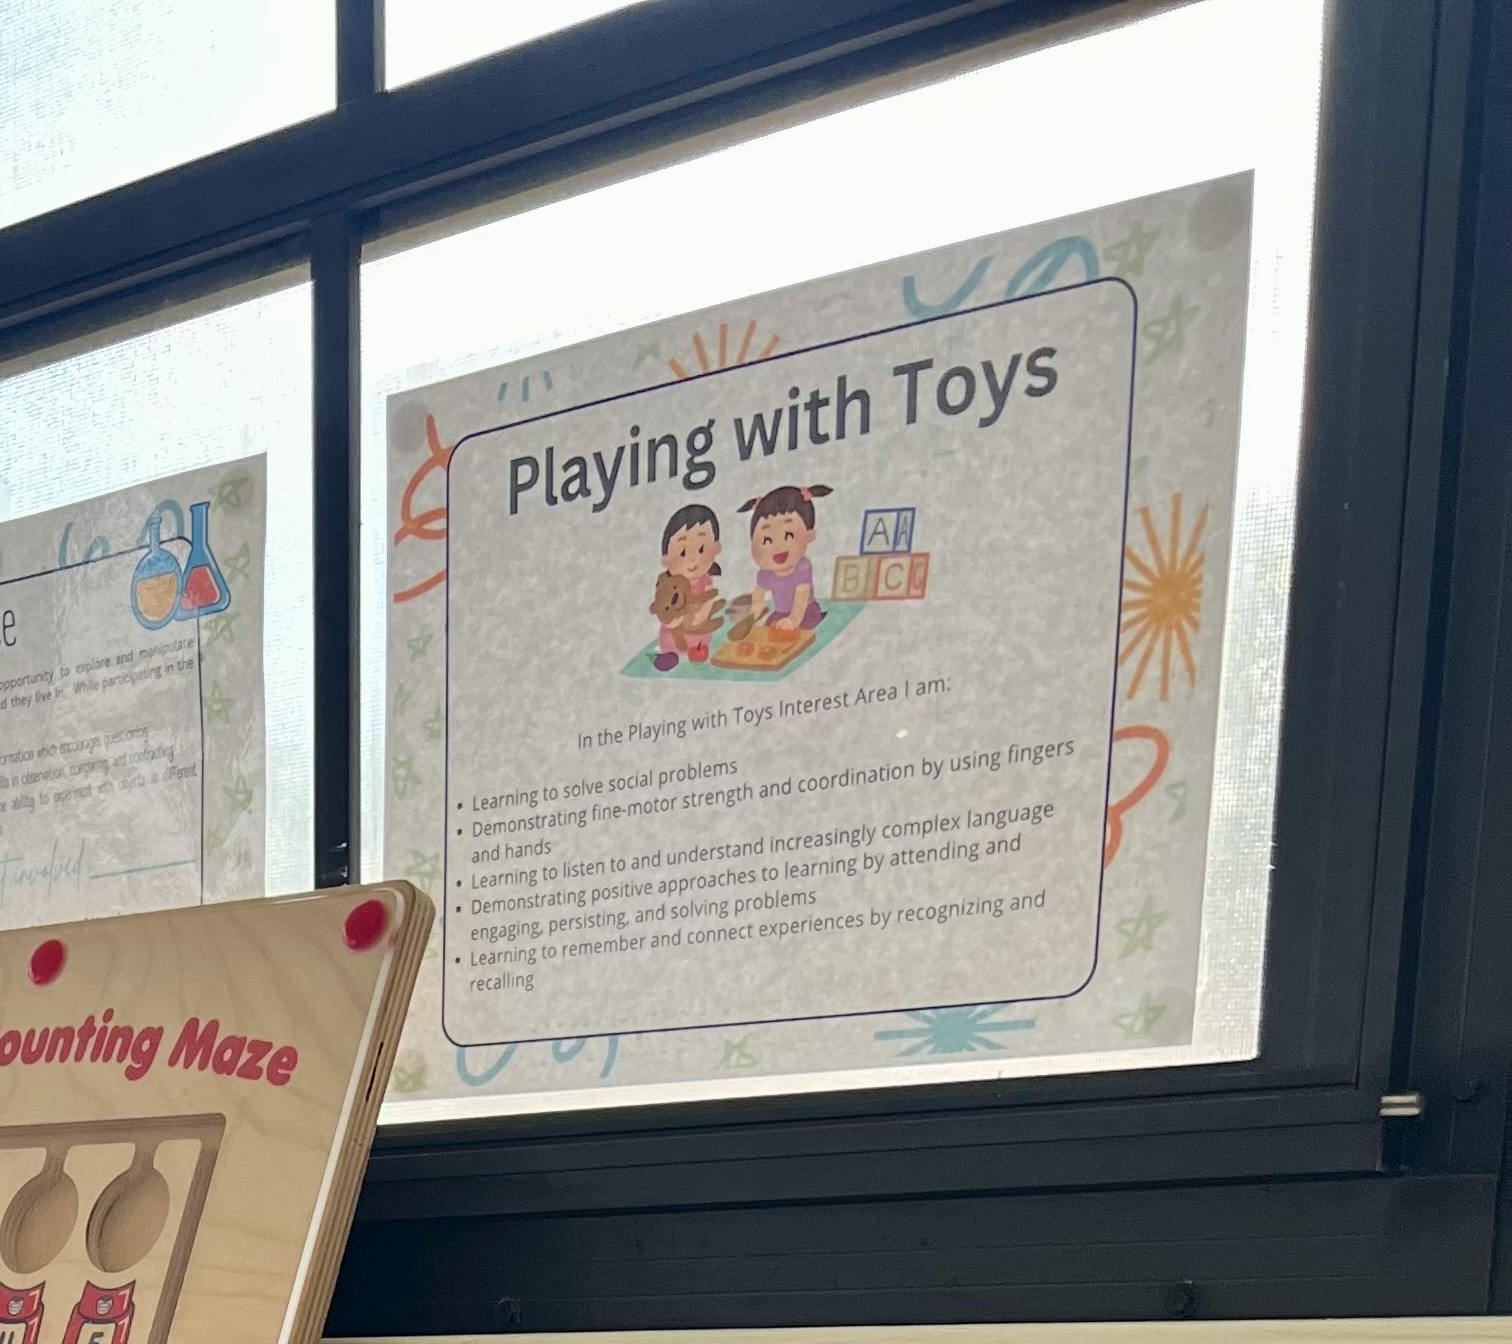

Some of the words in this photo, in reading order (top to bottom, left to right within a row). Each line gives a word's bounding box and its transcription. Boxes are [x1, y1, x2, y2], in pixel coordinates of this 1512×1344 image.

[509, 417, 717, 517] Playing
[733, 373, 871, 463] with
[892, 346, 1059, 430] Toys
[867, 517, 889, 546] A
[884, 562, 904, 590] C
[577, 733, 593, 750] In
[597, 727, 624, 747] the
[628, 719, 687, 744] Playing
[691, 709, 728, 731] with
[732, 705, 773, 728] Toys
[779, 691, 850, 718] Interest
[853, 685, 898, 707] Area
[904, 679, 910, 698] I
[915, 676, 951, 697] am:
[472, 788, 539, 812] Learning
[542, 786, 559, 802] to
[563, 778, 604, 799] solve
[608, 768, 653, 793] social
[658, 760, 738, 791] problems
[472, 809, 588, 838] Demonstrating
[591, 796, 678, 822] fine-motor
[682, 781, 754, 810] strength
[758, 776, 792, 799] and
[797, 762, 915, 794] coordination
[921, 757, 945, 780] by
[950, 750, 1002, 772] using
[1008, 739, 1075, 766] fingers
[471, 869, 538, 890] Learning
[542, 866, 559, 882] to
[562, 860, 605, 879] listen
[609, 857, 626, 873] to
[630, 848, 662, 871] and
[666, 835, 764, 866] understand
[770, 823, 877, 853] increasingly
[881, 813, 962, 840] complex
[967, 802, 1055, 830] language
[471, 843, 500, 865] and
[504, 838, 553, 860] hands
[471, 889, 587, 916] Demonstrating
[591, 880, 653, 907] positive
[657, 868, 757, 898] approaches
[761, 866, 779, 882] to
[784, 856, 858, 880] learning
[863, 851, 885, 874] by
[889, 840, 980, 867] attending
[985, 832, 1022, 856] and
[470, 920, 544, 944] engaging,
[548, 910, 630, 937] persisting,
[634, 902, 666, 924] and
[670, 899, 729, 920] solving
[734, 889, 817, 918] problems
[470, 946, 537, 967] Learning
[541, 945, 557, 960] to
[562, 934, 647, 958] remember
[650, 928, 682, 949] and
[687, 923, 754, 945] connect
[758, 913, 865, 940] experiences
[870, 907, 893, 930] by
[896, 897, 1005, 924] recognizing
[1009, 888, 1047, 911] and
[469, 972, 535, 992] recalling
[168, 1017, 299, 1086] Maze
